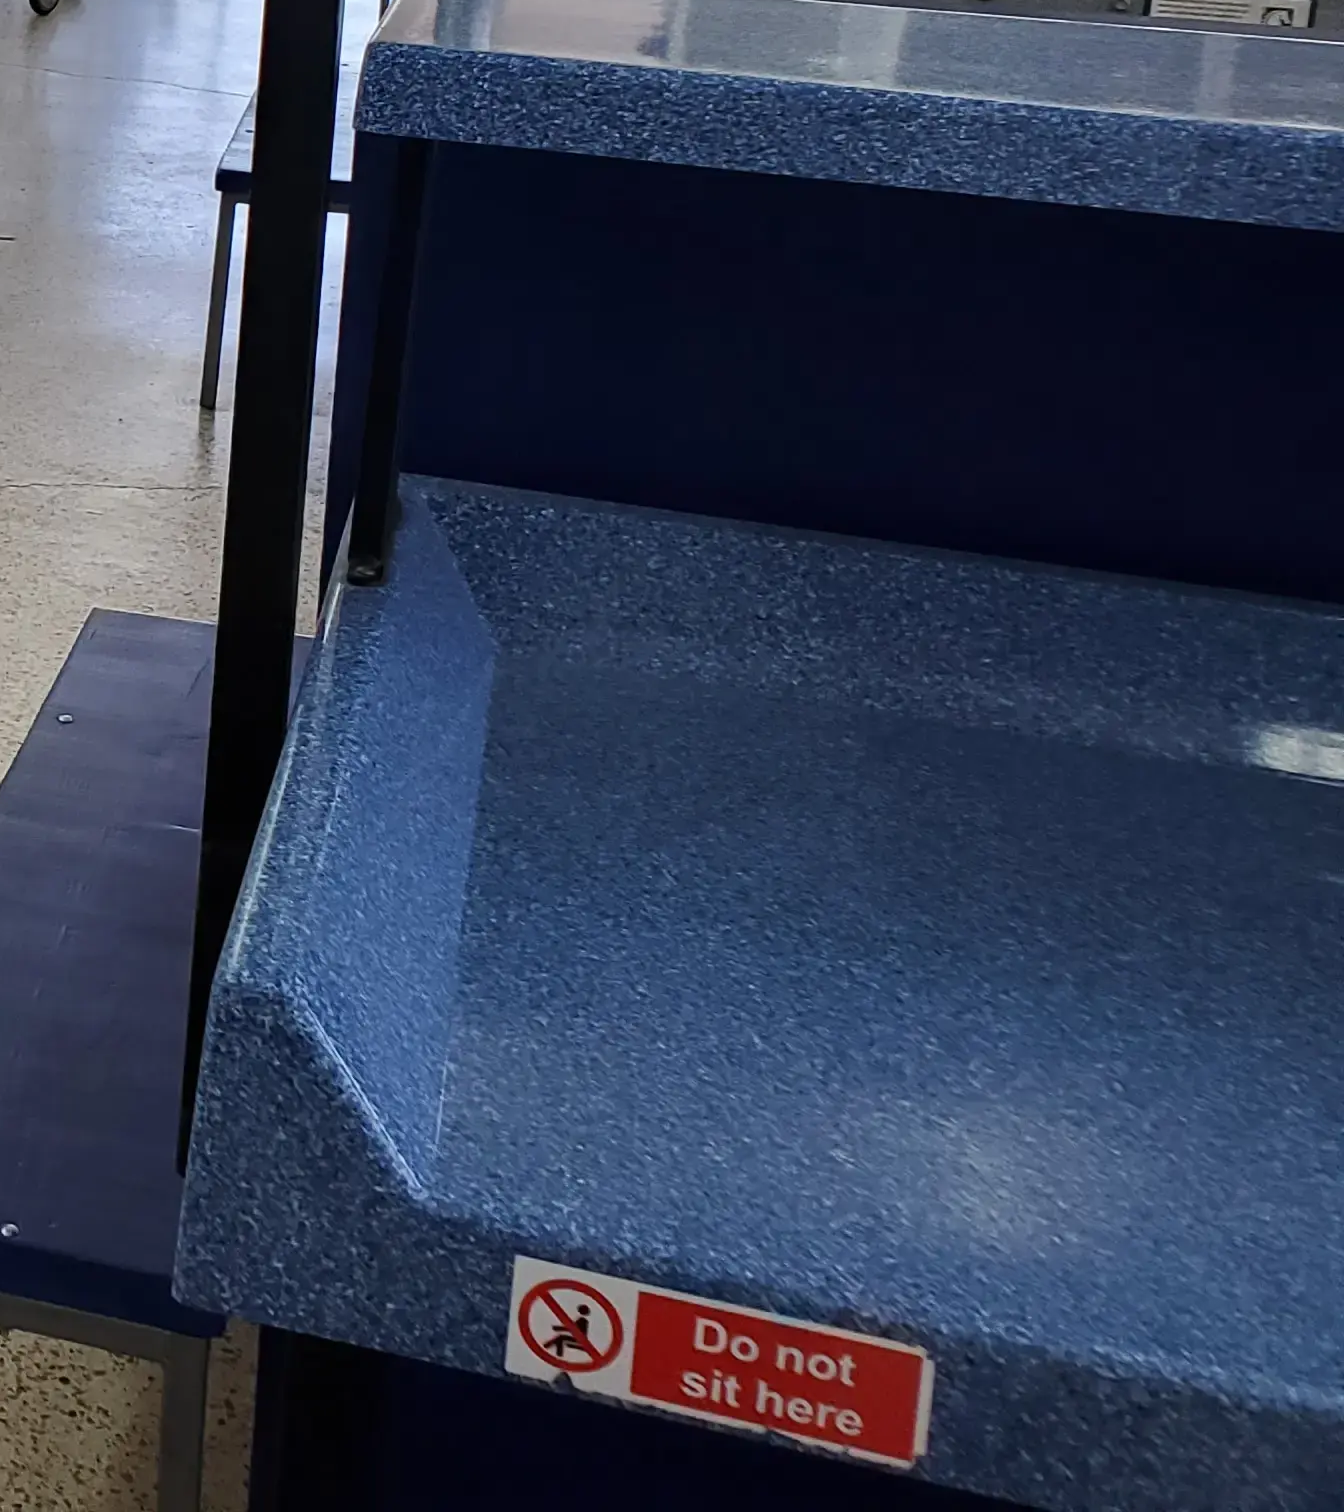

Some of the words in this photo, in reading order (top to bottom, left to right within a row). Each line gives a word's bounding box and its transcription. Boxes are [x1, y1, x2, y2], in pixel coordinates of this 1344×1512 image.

[693, 1316, 760, 1363] Do
[776, 1341, 858, 1387] not
[680, 1366, 742, 1410] sit
[756, 1378, 864, 1437] here
